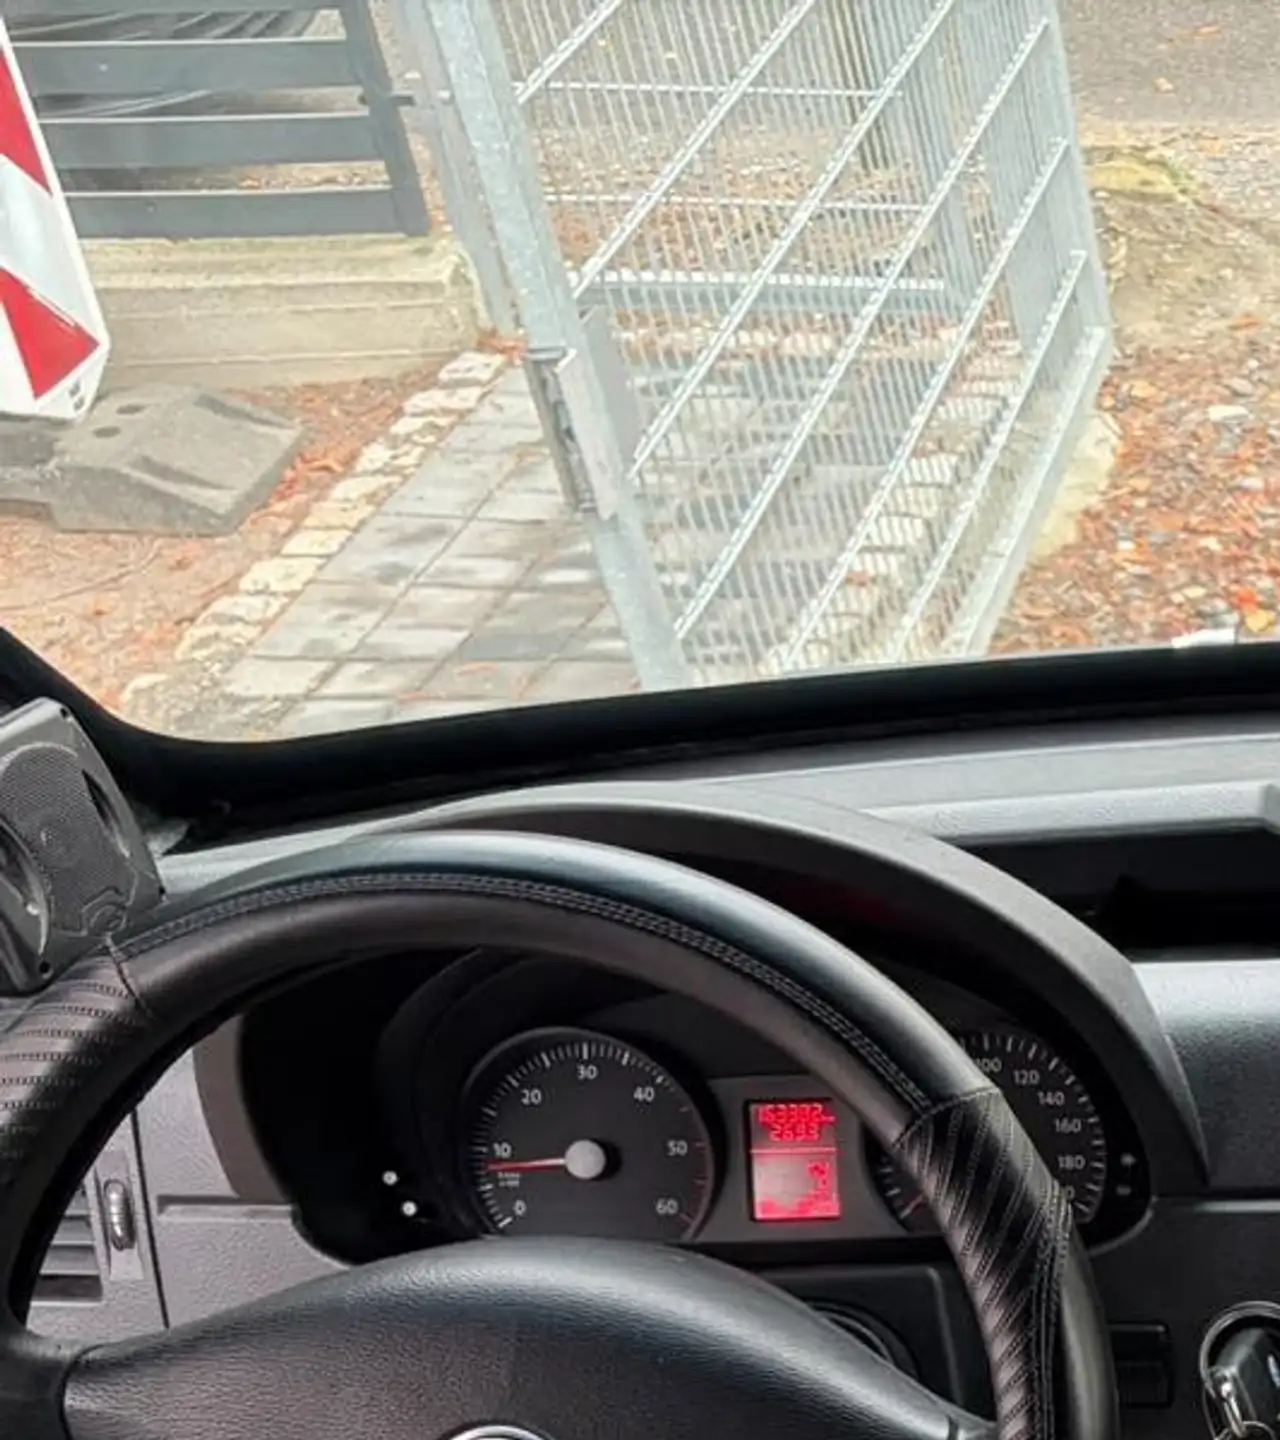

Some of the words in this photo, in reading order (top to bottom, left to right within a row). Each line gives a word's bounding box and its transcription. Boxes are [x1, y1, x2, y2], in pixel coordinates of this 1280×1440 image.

[577, 1065, 598, 1080] 30
[1013, 1070, 1040, 1084] 120
[521, 1089, 542, 1105] 20
[633, 1086, 655, 1102] 40
[1037, 1091, 1066, 1106] 140
[1054, 1119, 1081, 1133] 160
[493, 1142, 511, 1158] 10
[667, 1140, 688, 1156] 50
[1057, 1155, 1086, 1169] 180
[513, 1200, 527, 1216] 0
[656, 1199, 678, 1215] 60
